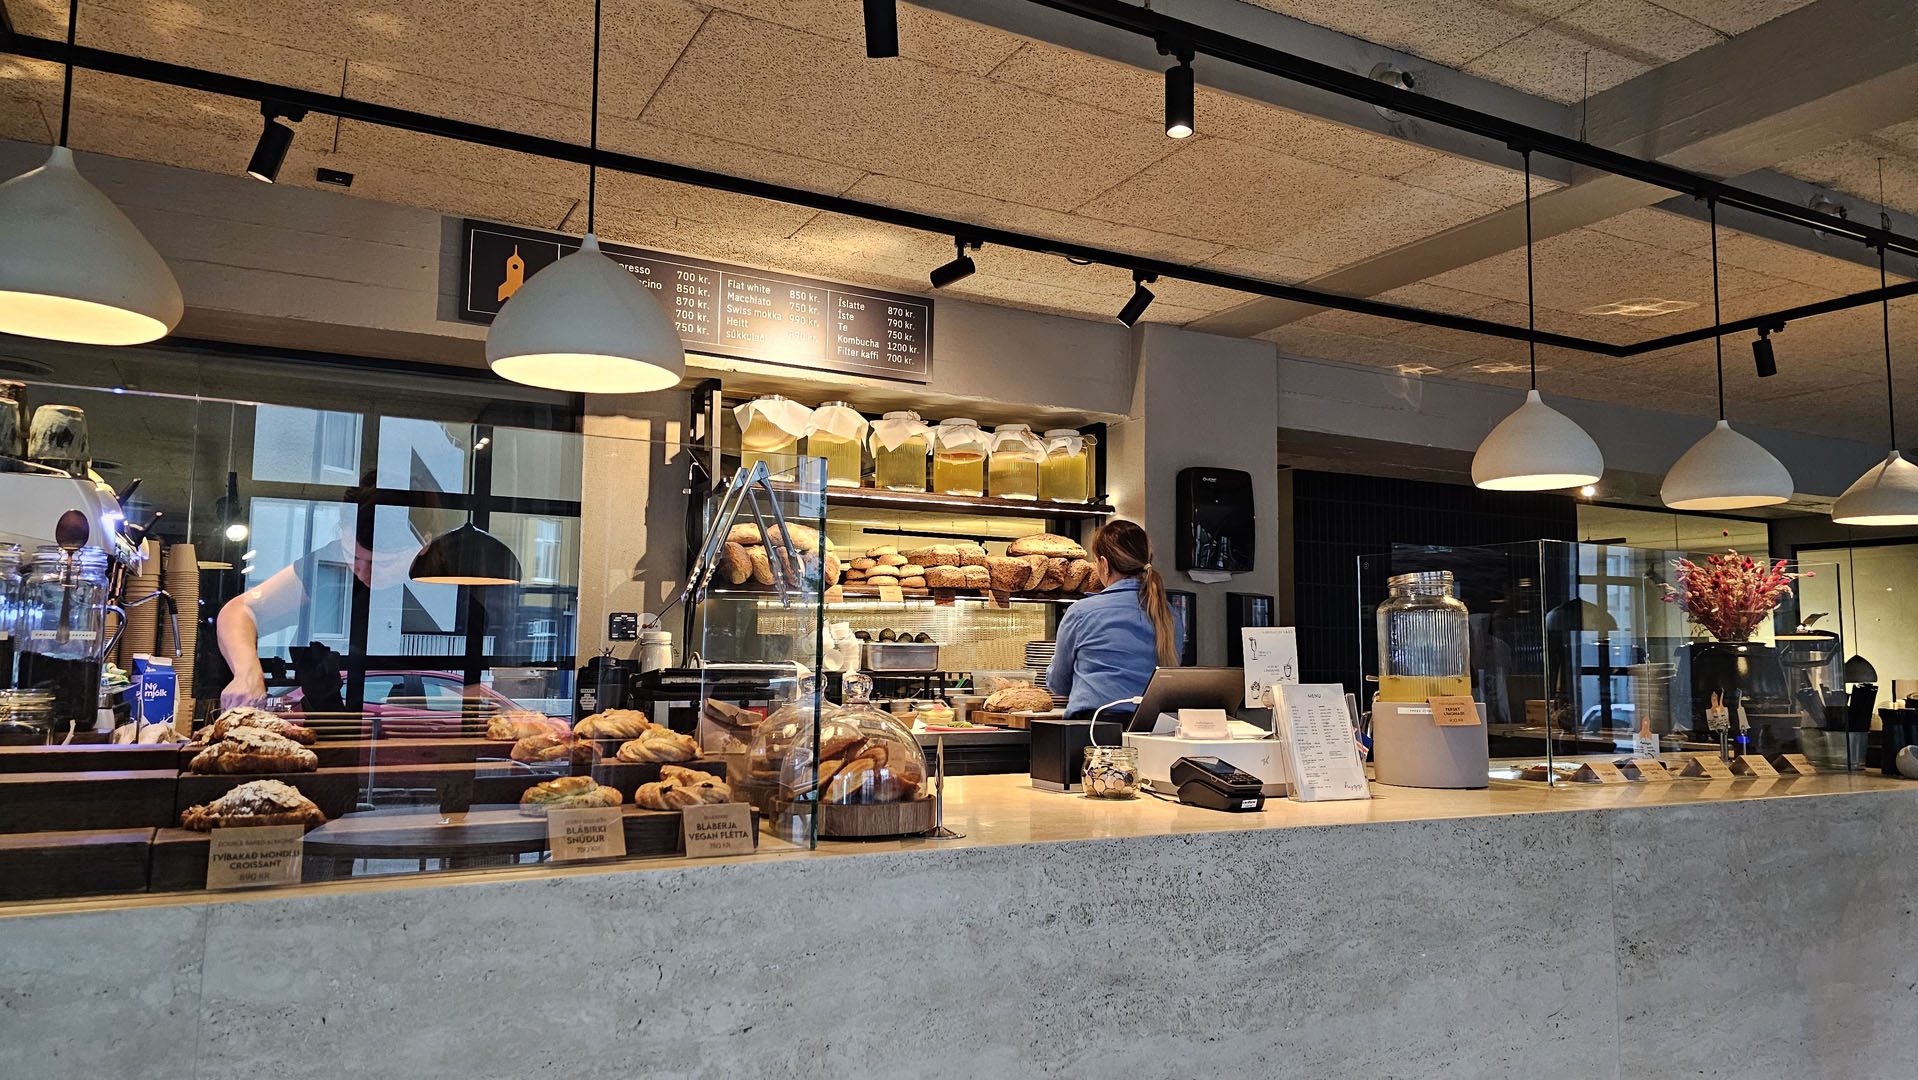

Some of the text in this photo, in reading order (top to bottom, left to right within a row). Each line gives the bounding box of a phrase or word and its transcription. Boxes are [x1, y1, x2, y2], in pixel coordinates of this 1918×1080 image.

[619, 263, 711, 285] resso 700 kr.
[676, 283, 695, 295] 850
[697, 286, 711, 298] kr.
[727, 279, 820, 303] Flat white 850 kr.
[675, 296, 710, 311] 870 kr.
[727, 292, 820, 315] Macchiato 750 kr.
[838, 296, 916, 319] Íslatte 870 kr.
[675, 309, 710, 323] 700 kr.
[726, 304, 820, 328] Swiss mokka 990 kr.
[726, 316, 749, 328] Heitt
[887, 318, 903, 328] 790
[904, 320, 916, 331] kr.
[674, 321, 709, 336] 750 kr.
[837, 322, 915, 342] Te 750 kr.
[837, 334, 920, 355] Kombucha 1200 kr.
[837, 346, 915, 365] Filter kaffi 700 kr.
[688, 831, 718, 840] VEGAN
[229, 859, 282, 870] CROISSANT
